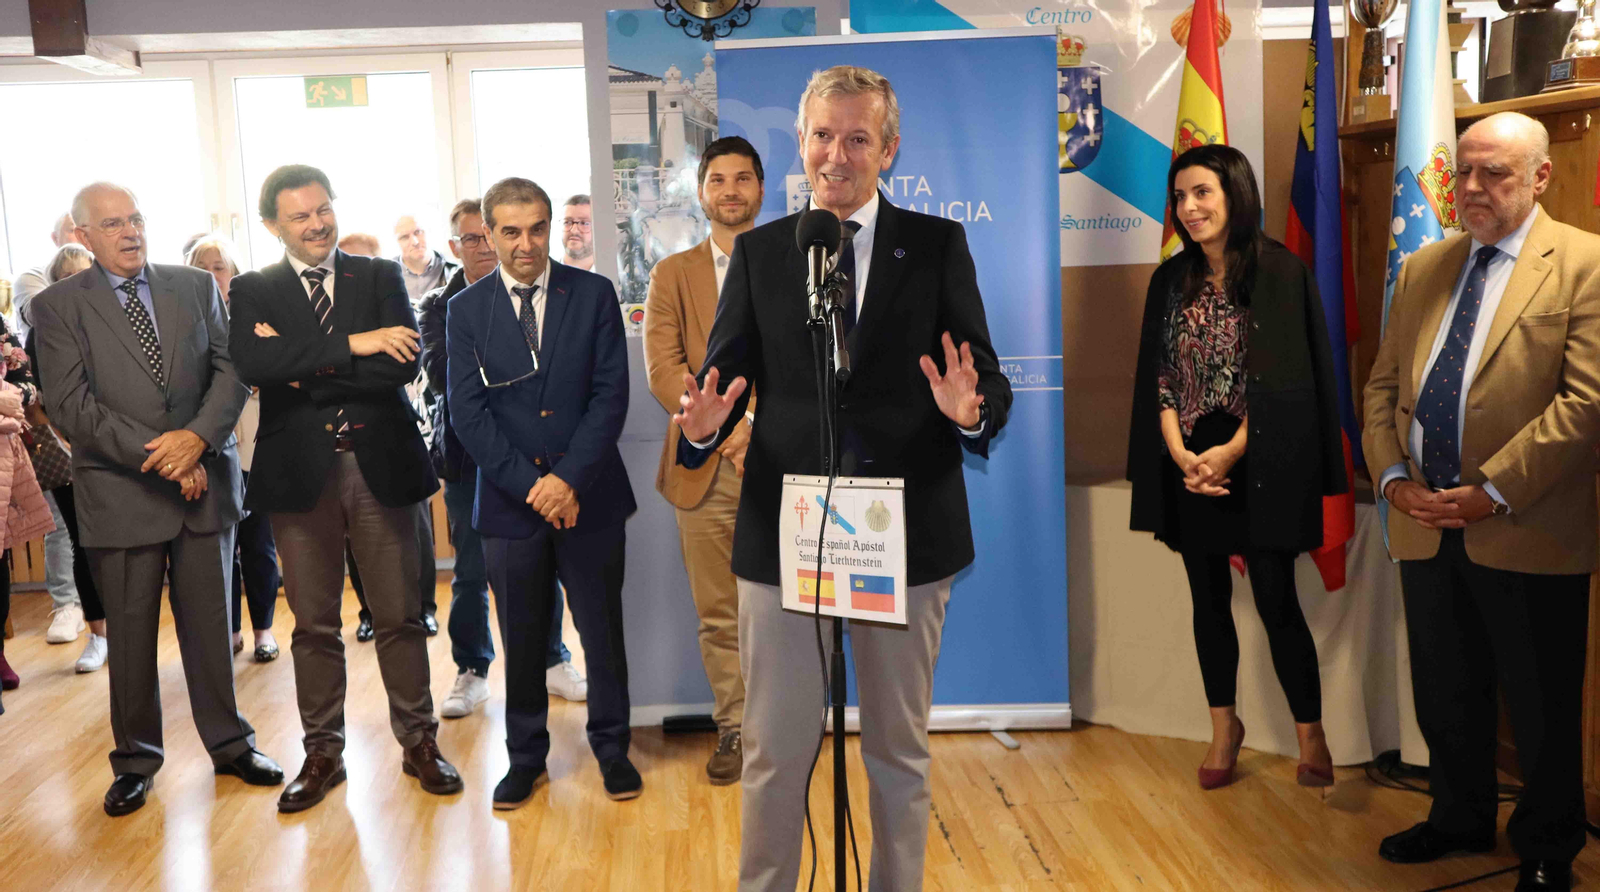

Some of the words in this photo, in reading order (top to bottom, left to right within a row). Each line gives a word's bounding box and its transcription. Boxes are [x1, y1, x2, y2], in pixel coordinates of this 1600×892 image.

[1026, 6, 1092, 25] Centro
[878, 175, 933, 197] NTA
[1060, 213, 1142, 233] Santiago
[999, 364, 1023, 374] NTA
[1006, 374, 1048, 385] ALICIA
[795, 534, 818, 548] Centro
[852, 540, 886, 553] Apóstol
[828, 552, 883, 568] Liechtenstein
